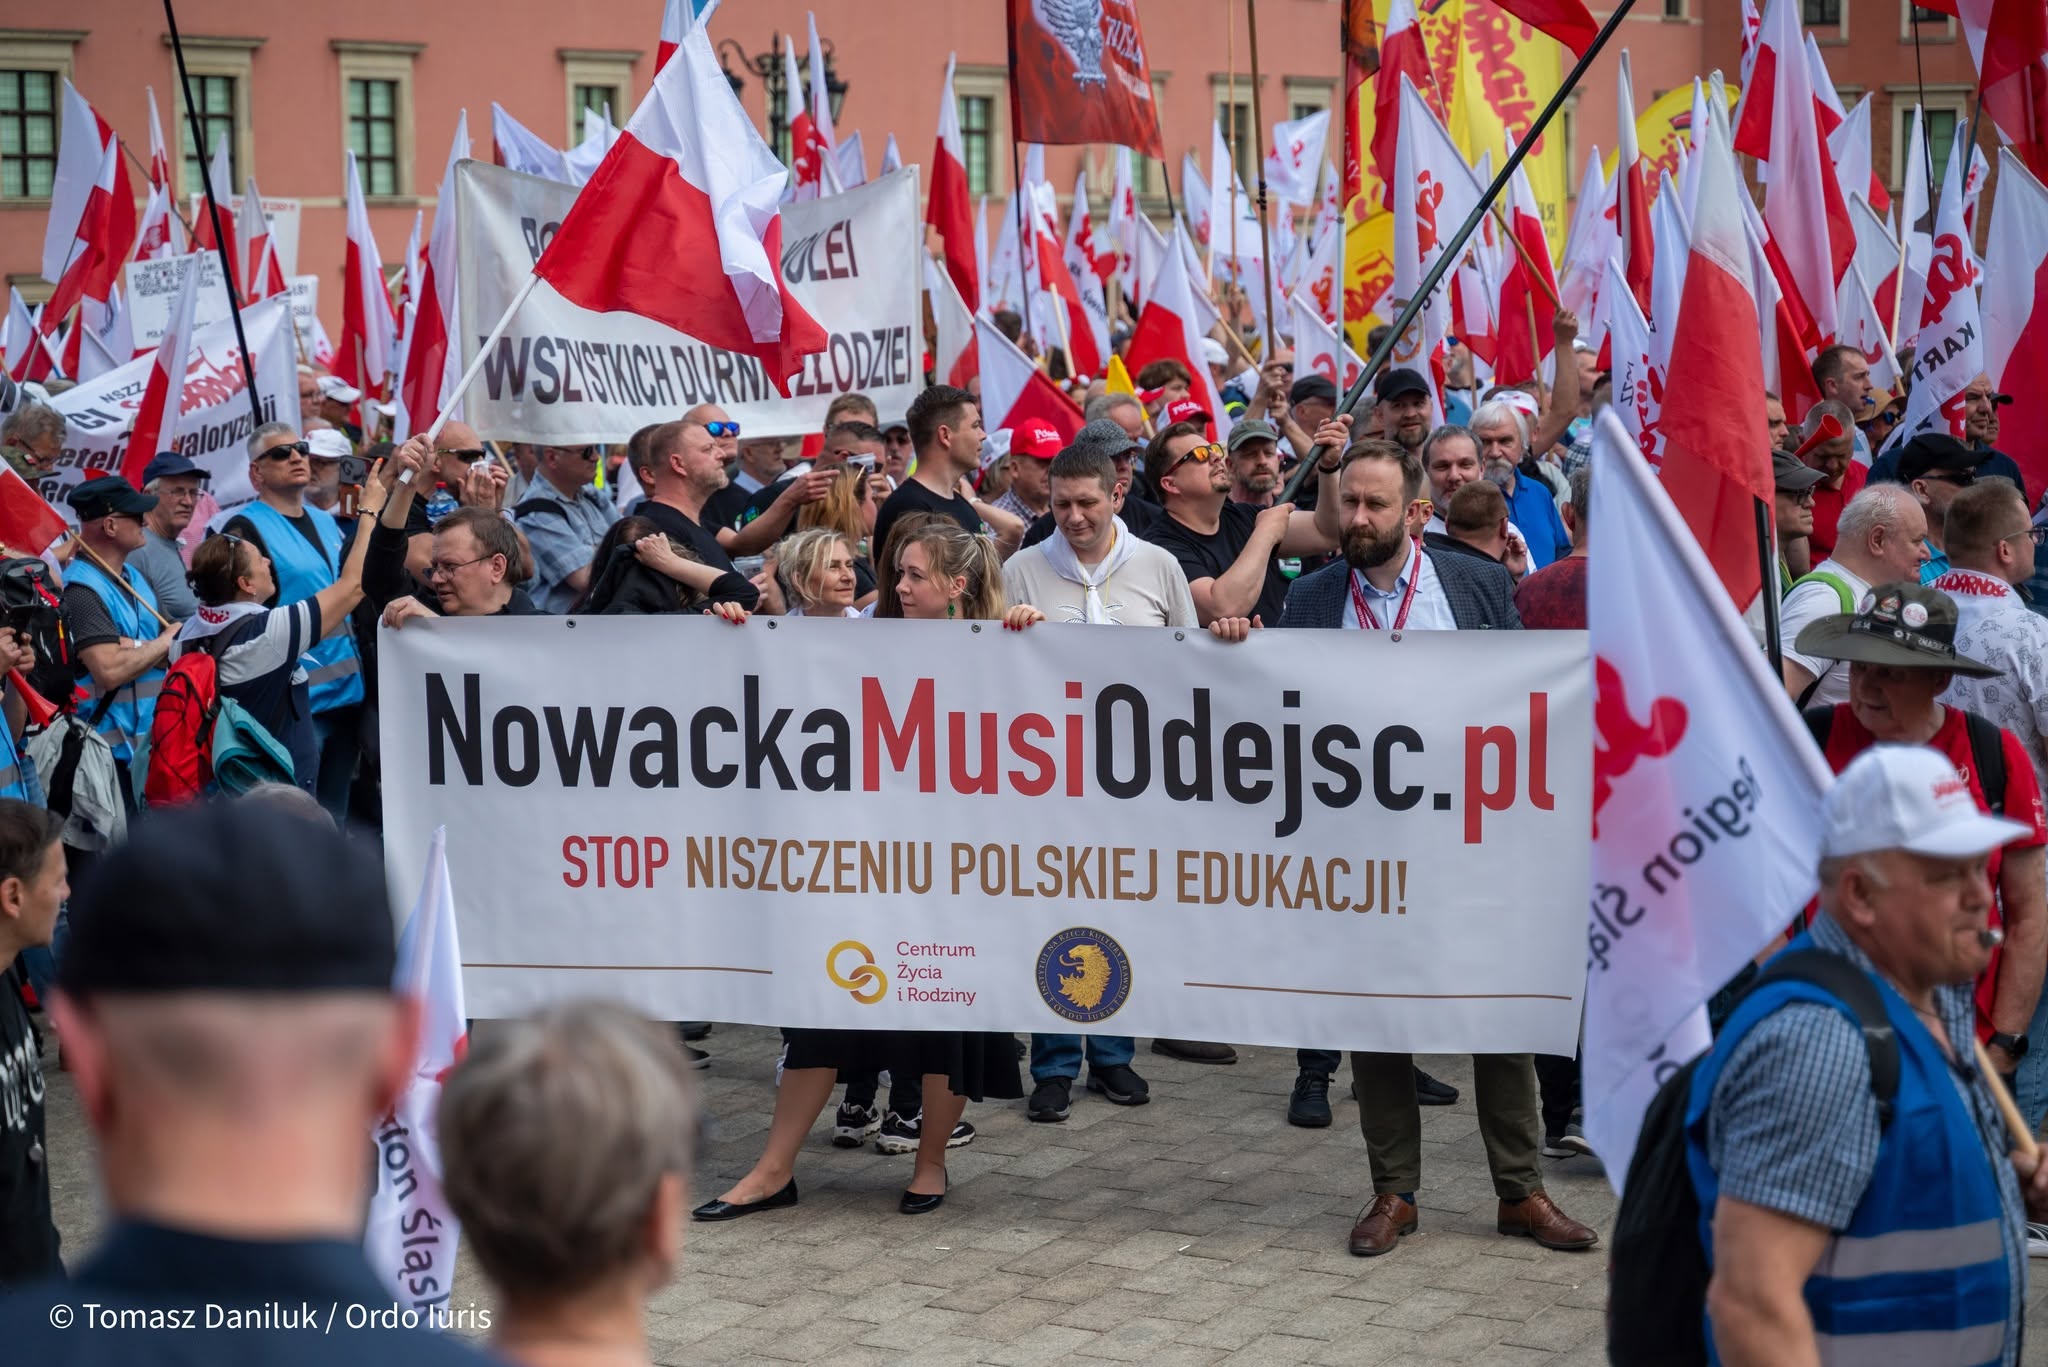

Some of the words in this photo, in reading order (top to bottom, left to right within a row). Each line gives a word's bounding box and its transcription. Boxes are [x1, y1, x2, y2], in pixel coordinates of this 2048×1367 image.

[479, 336, 676, 406] WSZYSTKICH
[99, 381, 146, 403] NSZZ
[425, 672, 1554, 844] NowackaMusiOdejsc.pl
[562, 835, 669, 889] STOP
[687, 836, 932, 895] NISZCZENIU
[952, 843, 1158, 901] POLSKIEJ
[1177, 851, 1407, 914] EDUKACJI!
[896, 941, 976, 957] Centrum
[1047, 941, 1058, 952] NA
[897, 961, 942, 982] Życia
[897, 987, 903, 1002] i
[907, 987, 976, 1006] Rodziny
